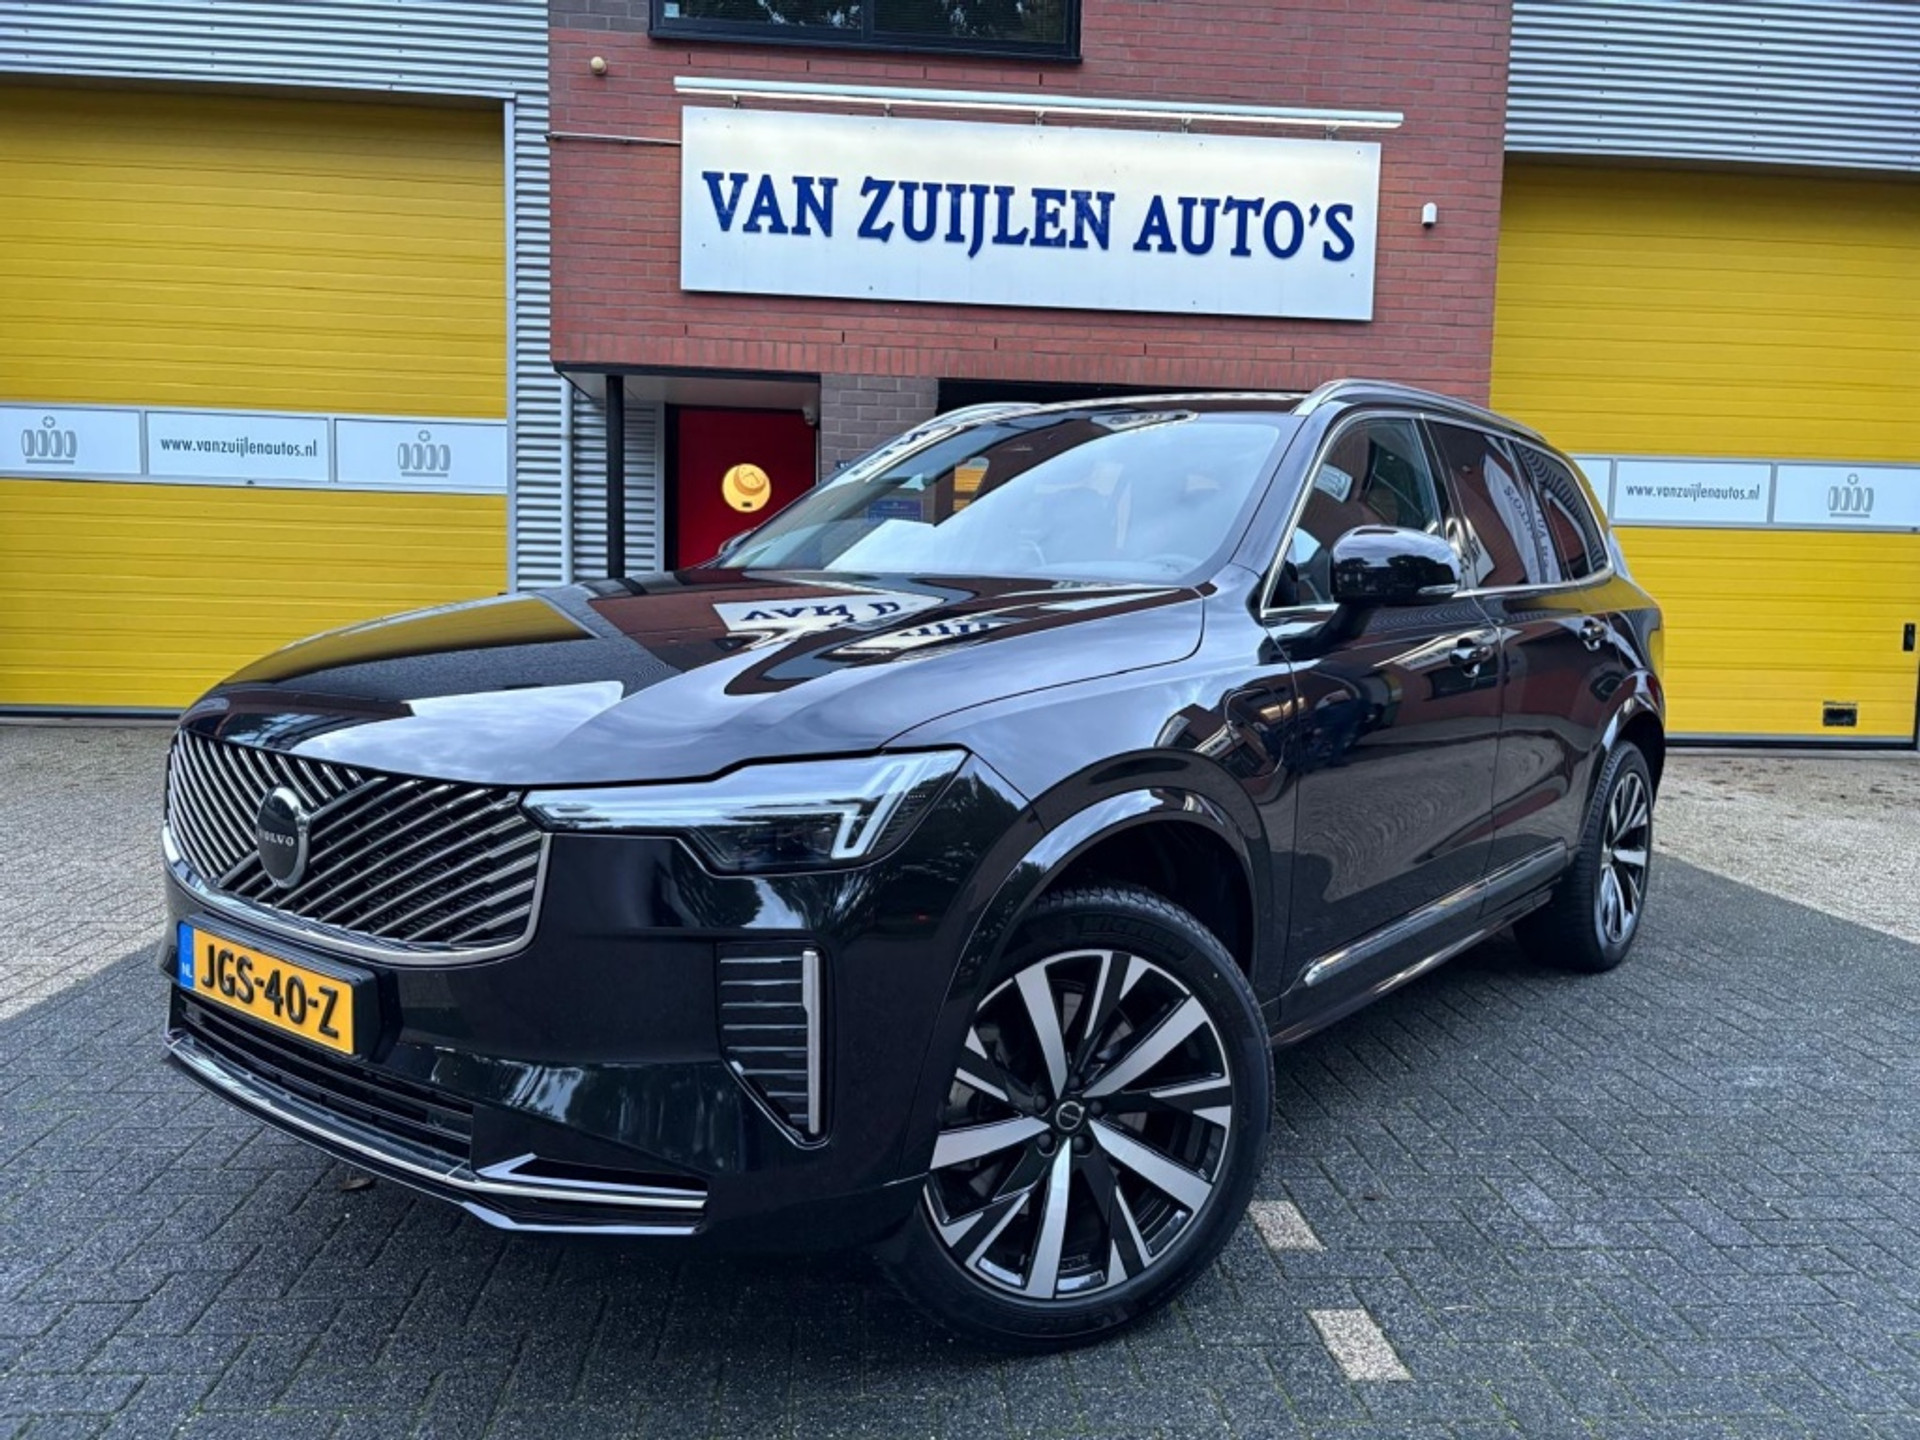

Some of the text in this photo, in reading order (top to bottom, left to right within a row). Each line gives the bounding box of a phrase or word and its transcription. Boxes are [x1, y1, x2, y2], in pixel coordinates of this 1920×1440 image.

[703, 172, 1354, 261] VAN ZUIJLEN AUTO'S
[160, 437, 318, 458] www.vanzuijlenautos.nl
[1625, 482, 1761, 502] www.vanzuijlenautos.nl
[182, 962, 192, 978] NL
[202, 944, 339, 1039] JGS-40-Z
